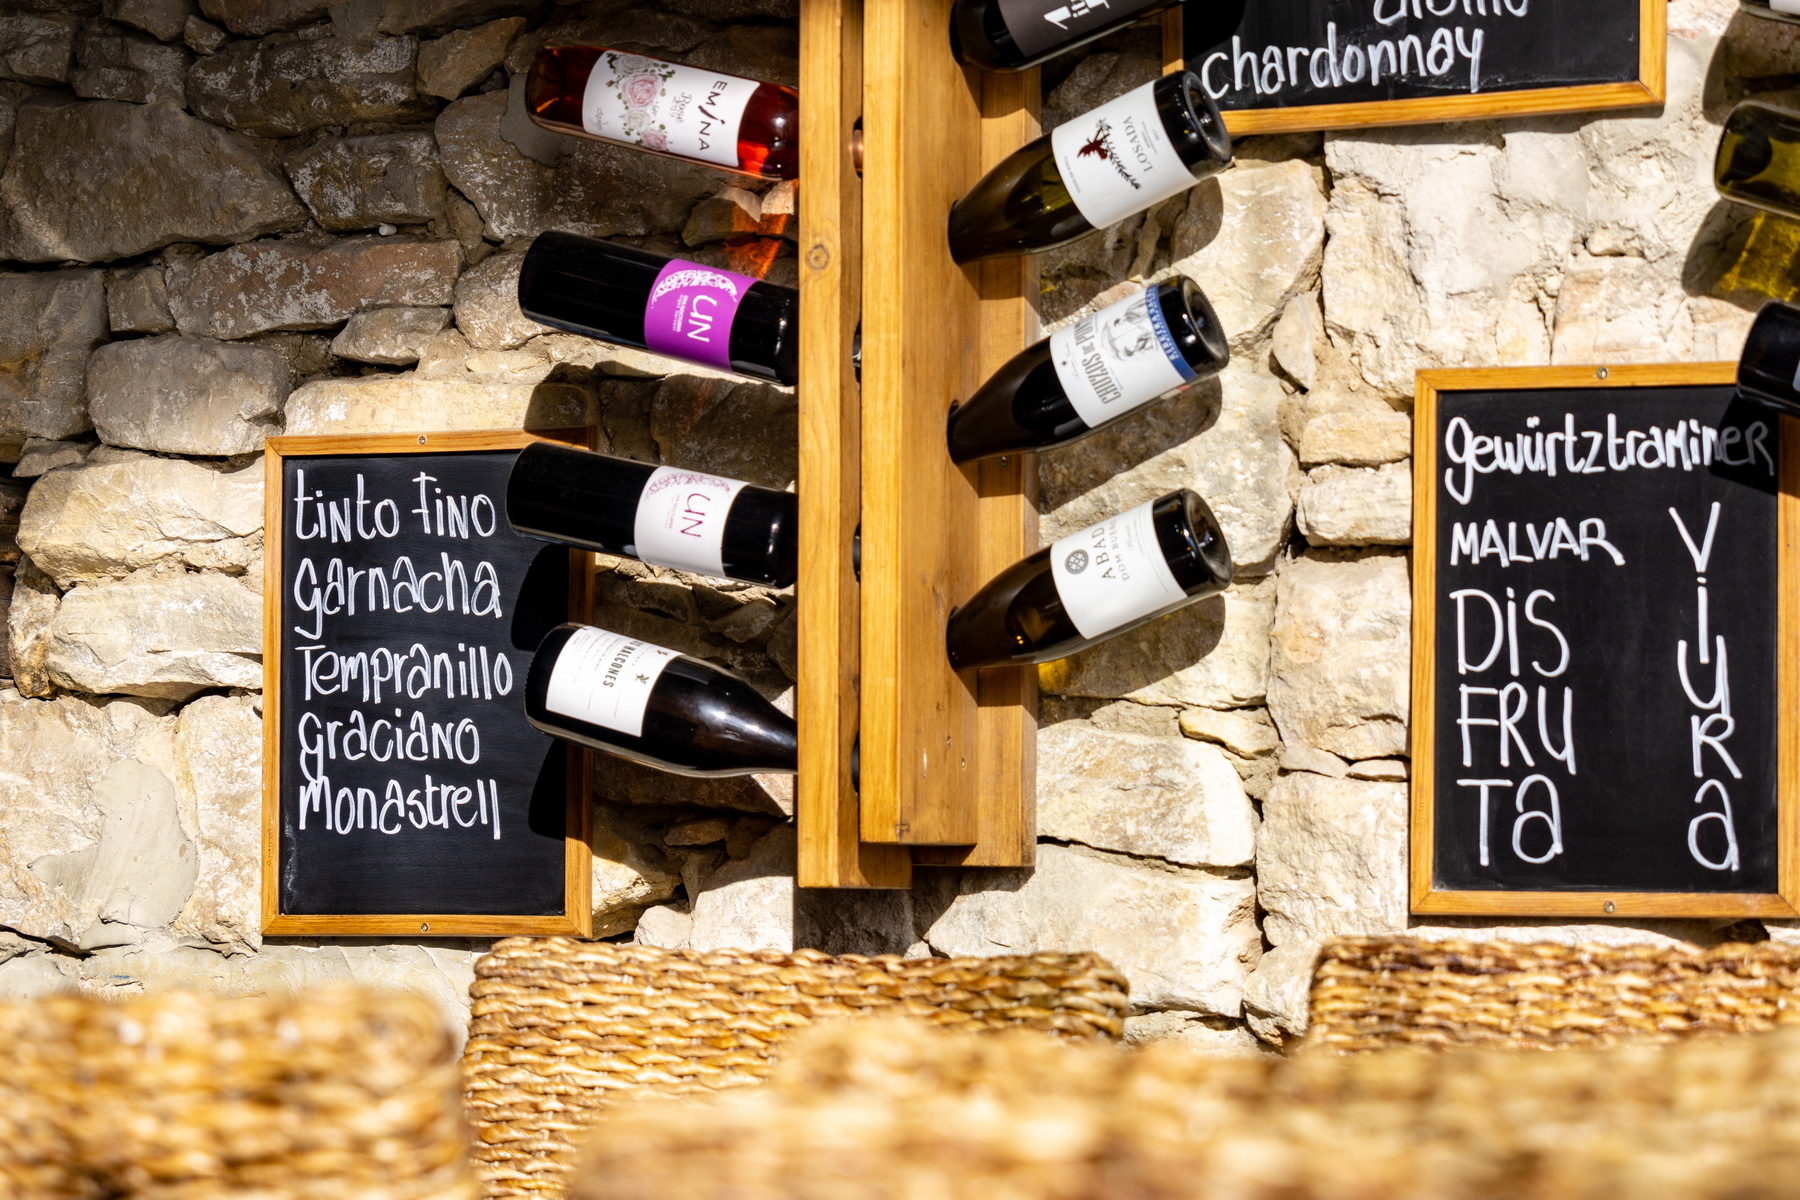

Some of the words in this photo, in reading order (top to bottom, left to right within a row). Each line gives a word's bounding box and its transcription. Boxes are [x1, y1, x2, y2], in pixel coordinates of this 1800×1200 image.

[1201, 21, 1484, 100] chardonnay
[1122, 115, 1153, 172] LOSADA
[687, 295, 718, 343] UN
[1082, 353, 1122, 405] CHUZOS
[680, 493, 710, 538] UN
[1091, 527, 1116, 580] ABAD
[1115, 553, 1131, 581] DOM
[1450, 516, 1626, 568] MALVAR
[295, 642, 513, 704] Tempranillo
